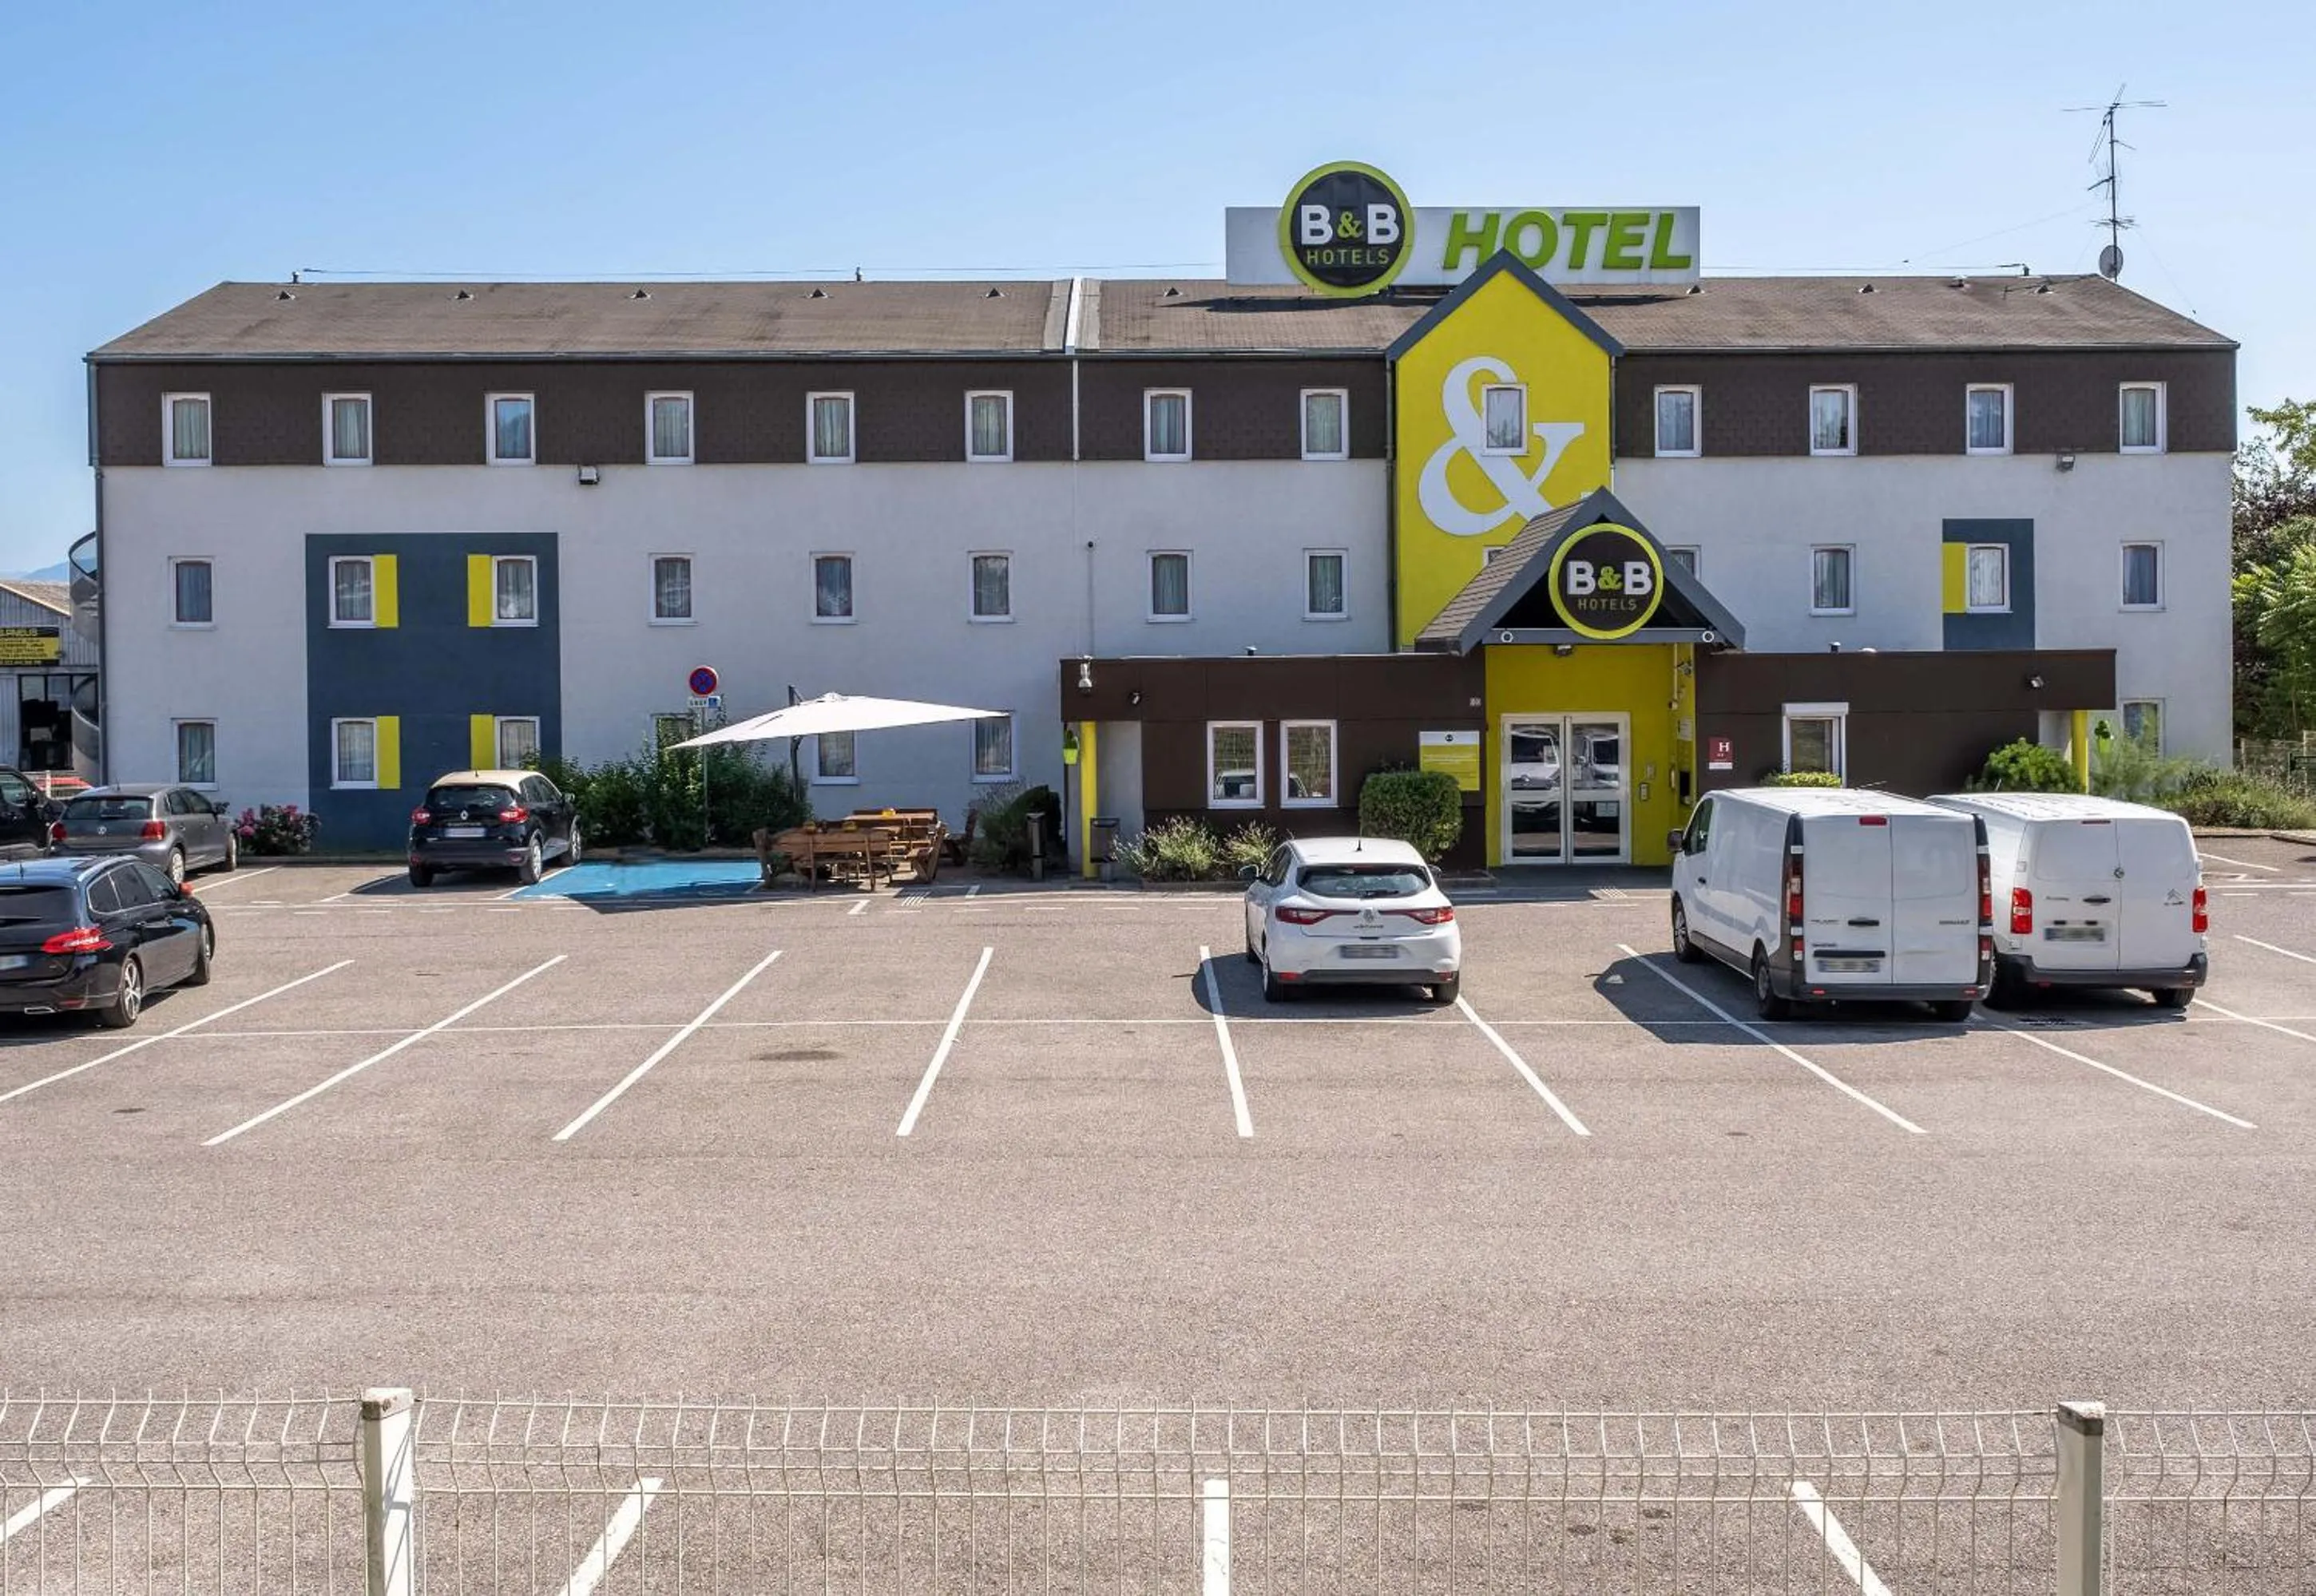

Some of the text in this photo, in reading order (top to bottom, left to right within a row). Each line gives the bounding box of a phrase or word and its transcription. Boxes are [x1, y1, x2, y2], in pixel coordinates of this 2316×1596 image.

[1301, 204, 1399, 244] B&B
[1442, 211, 1691, 271] HOTEL
[1307, 248, 1390, 265] HOTELS
[1418, 356, 1584, 537] &
[1567, 560, 1652, 595] B&B
[1578, 599, 1637, 611] HOTELS
[1719, 742, 1730, 752] H
